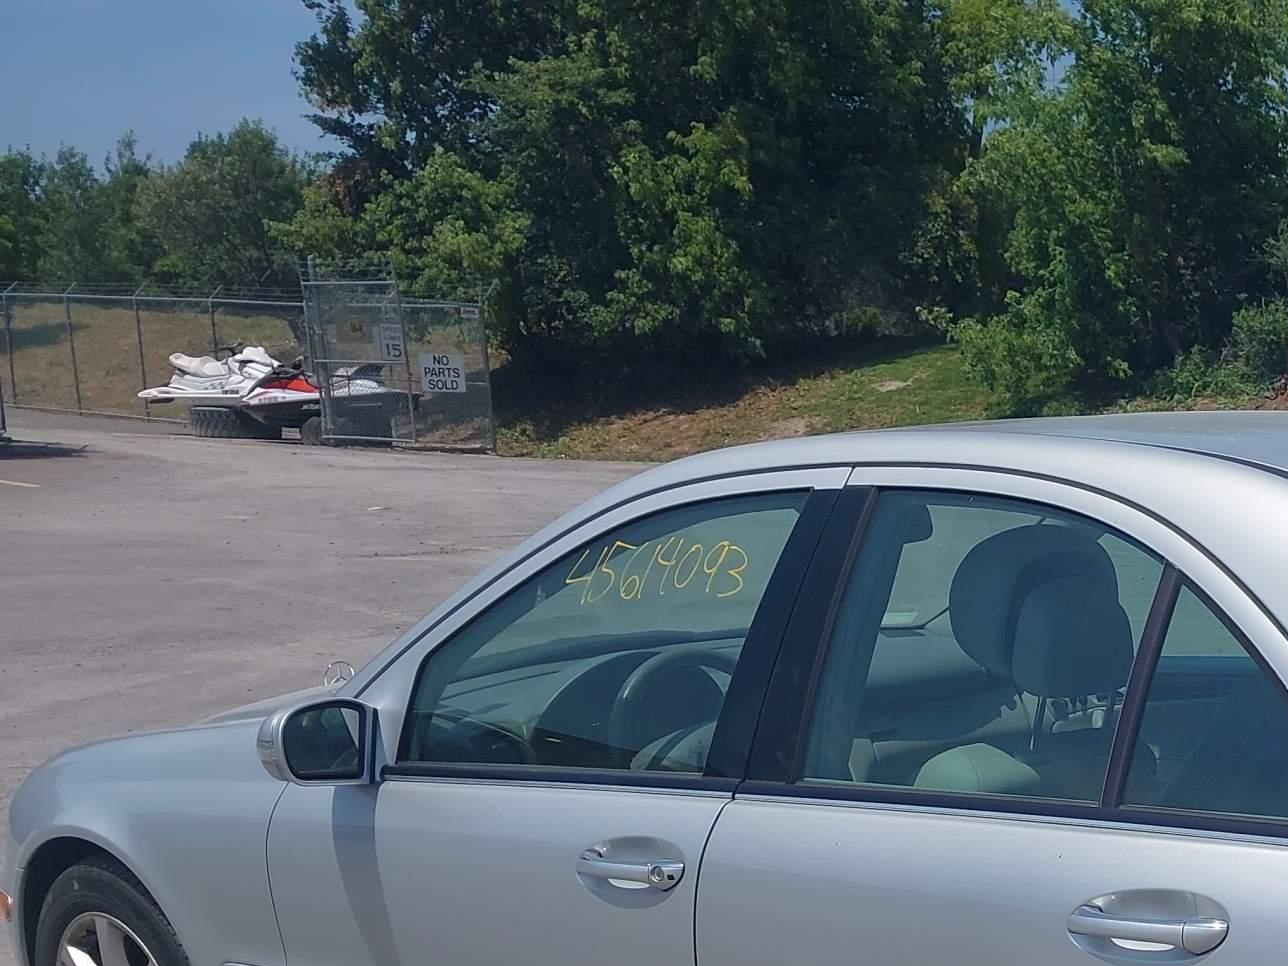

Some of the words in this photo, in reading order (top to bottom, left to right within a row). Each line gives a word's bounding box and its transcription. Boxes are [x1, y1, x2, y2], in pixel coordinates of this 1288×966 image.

[385, 343, 402, 358] 15
[433, 355, 449, 366] NO
[424, 366, 460, 378] PARTS
[428, 379, 459, 390] SOLD
[566, 537, 748, 605] 45614093
